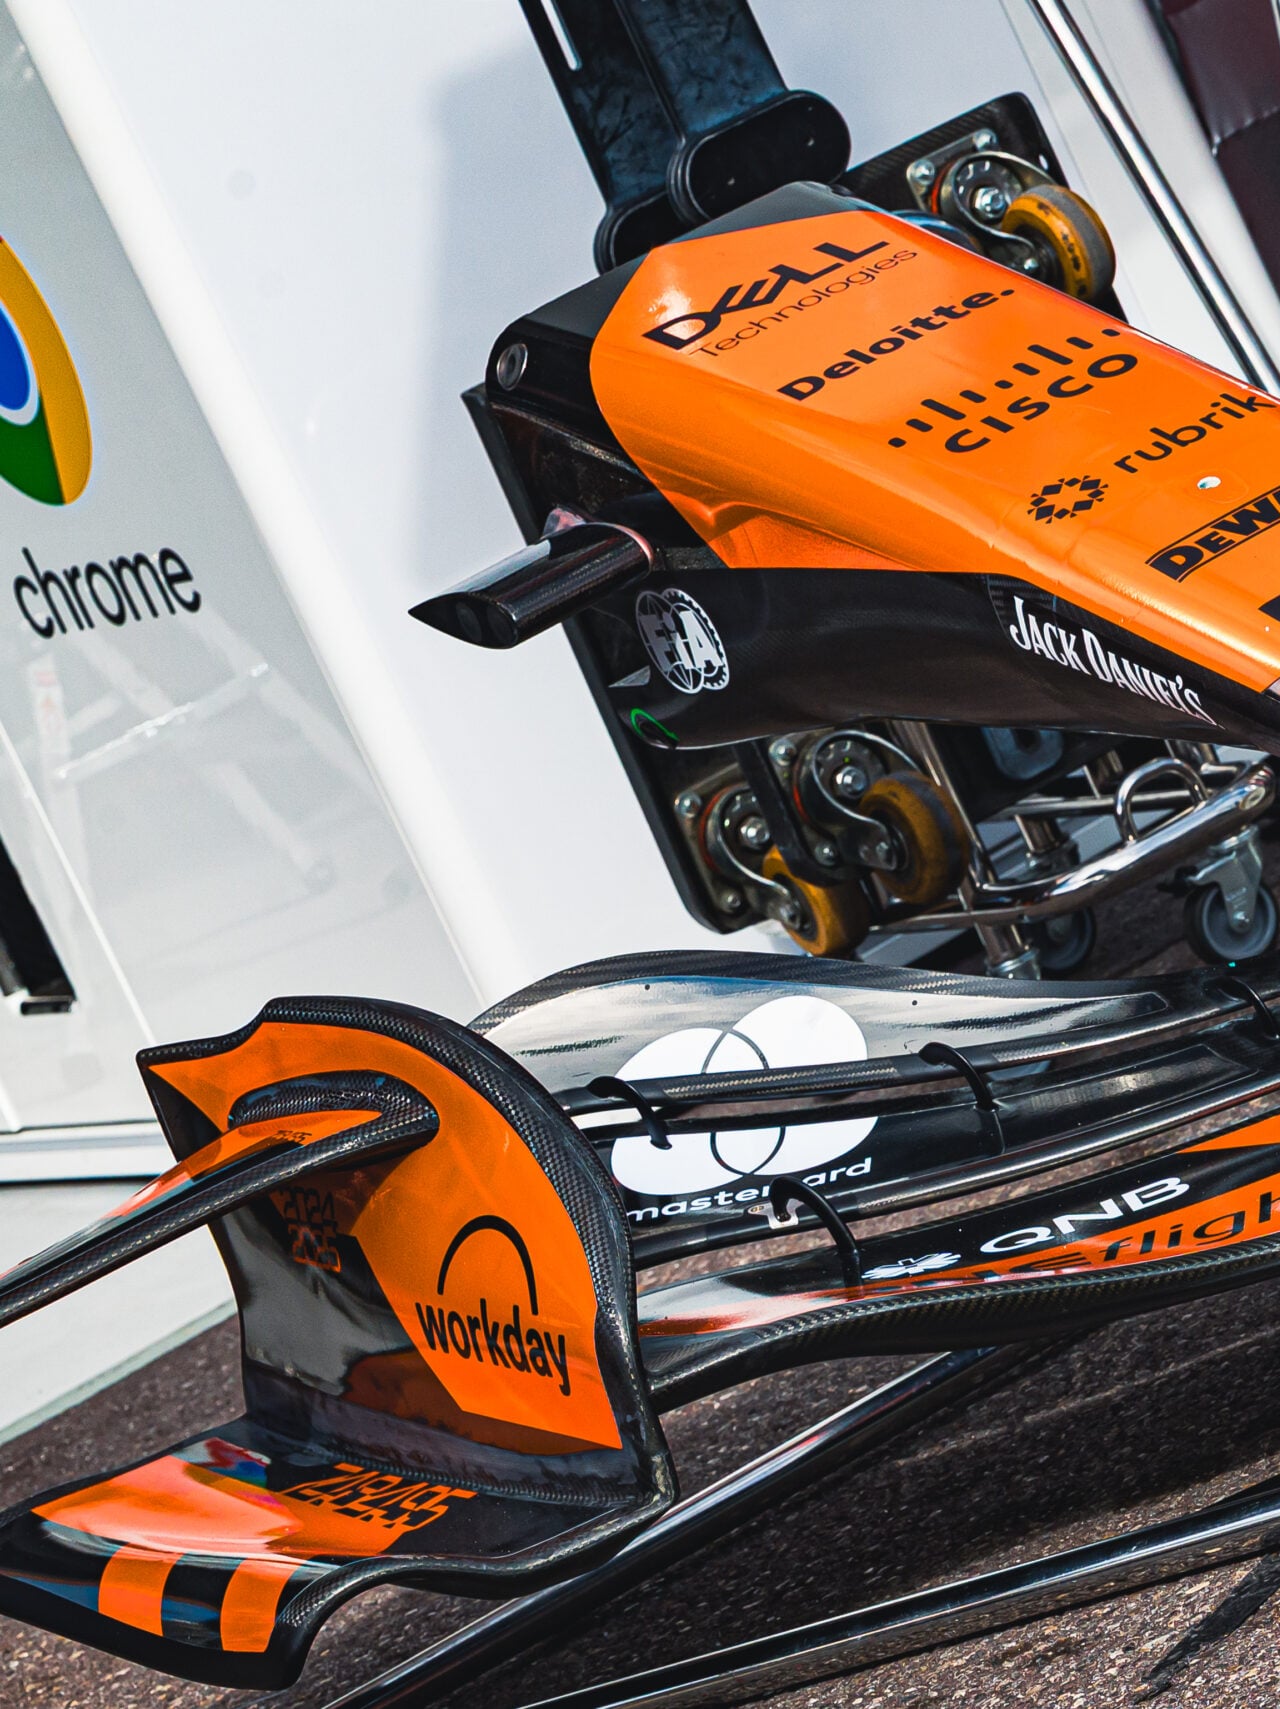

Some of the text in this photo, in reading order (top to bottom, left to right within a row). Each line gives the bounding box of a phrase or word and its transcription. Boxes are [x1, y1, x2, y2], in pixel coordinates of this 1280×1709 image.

[641, 240, 890, 350] DELL
[689, 249, 918, 357] Technologies
[777, 287, 1015, 401] Deloitte.
[1113, 392, 1277, 474] rubrik
[12, 546, 202, 640] chrome
[627, 1156, 872, 1222] masterard
[980, 1176, 1190, 1254] QNB
[415, 1298, 571, 1397] workday
